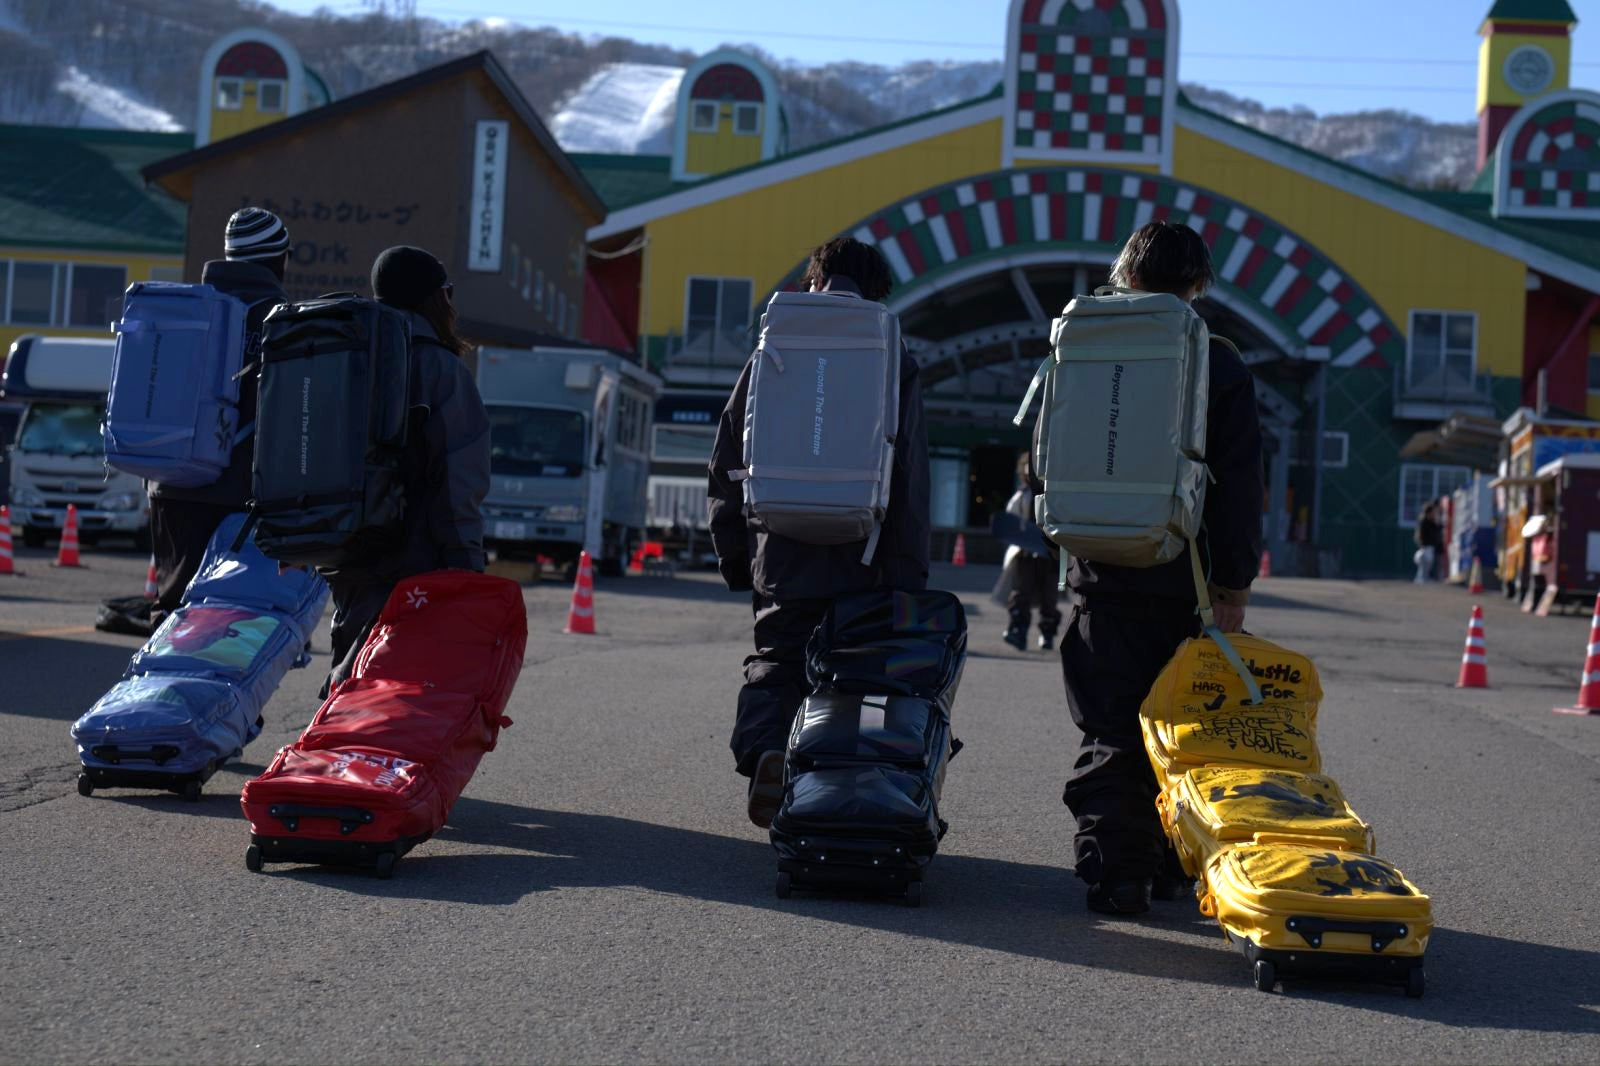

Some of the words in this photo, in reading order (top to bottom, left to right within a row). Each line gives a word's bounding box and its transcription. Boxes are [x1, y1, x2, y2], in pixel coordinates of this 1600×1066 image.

[479, 171, 495, 260] KITCHEN
[815, 358, 827, 394] Beyond
[1112, 364, 1124, 405] Beyond
[302, 377, 311, 412] Beyond
[815, 396, 825, 414] The
[301, 415, 309, 432] The
[813, 415, 824, 456] Extreme
[1110, 408, 1120, 428] The
[300, 435, 309, 475] Extreme
[1106, 430, 1118, 476] Extreme
[1192, 681, 1226, 694] HARD
